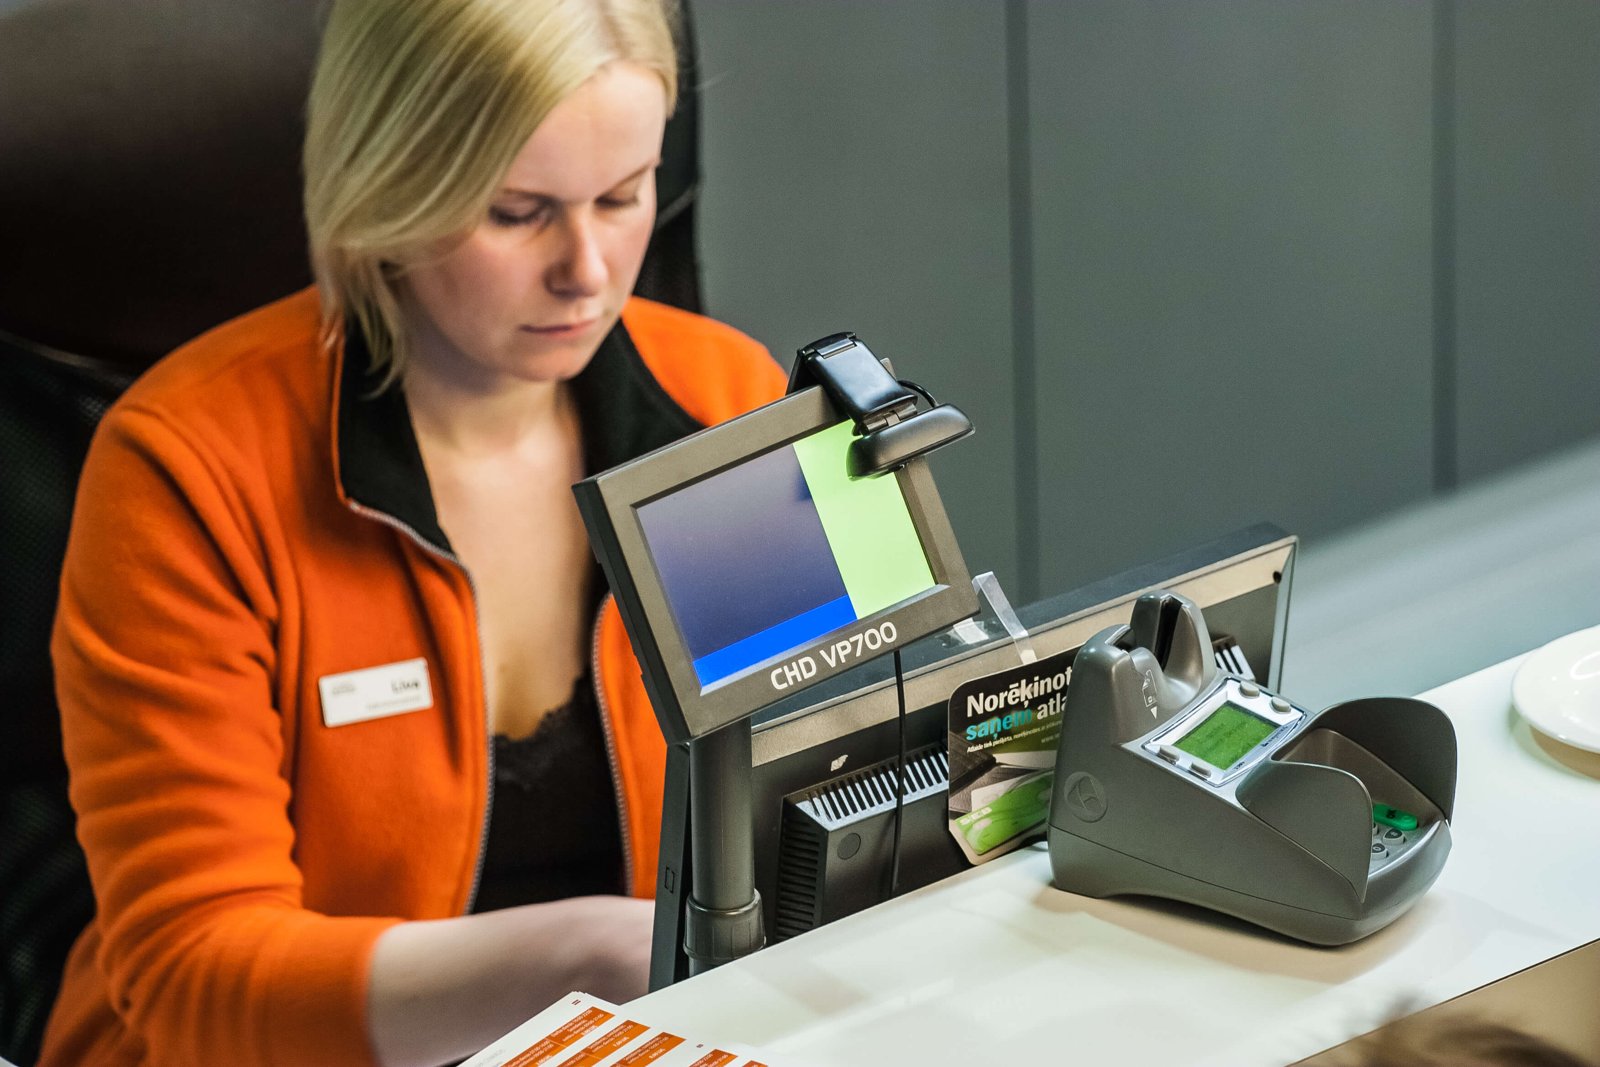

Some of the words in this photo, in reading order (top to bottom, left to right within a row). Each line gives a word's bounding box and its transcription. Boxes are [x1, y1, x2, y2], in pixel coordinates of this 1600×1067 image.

[770, 656, 817, 690] CHD
[819, 621, 897, 668] VP700
[966, 708, 1033, 741] saņem
